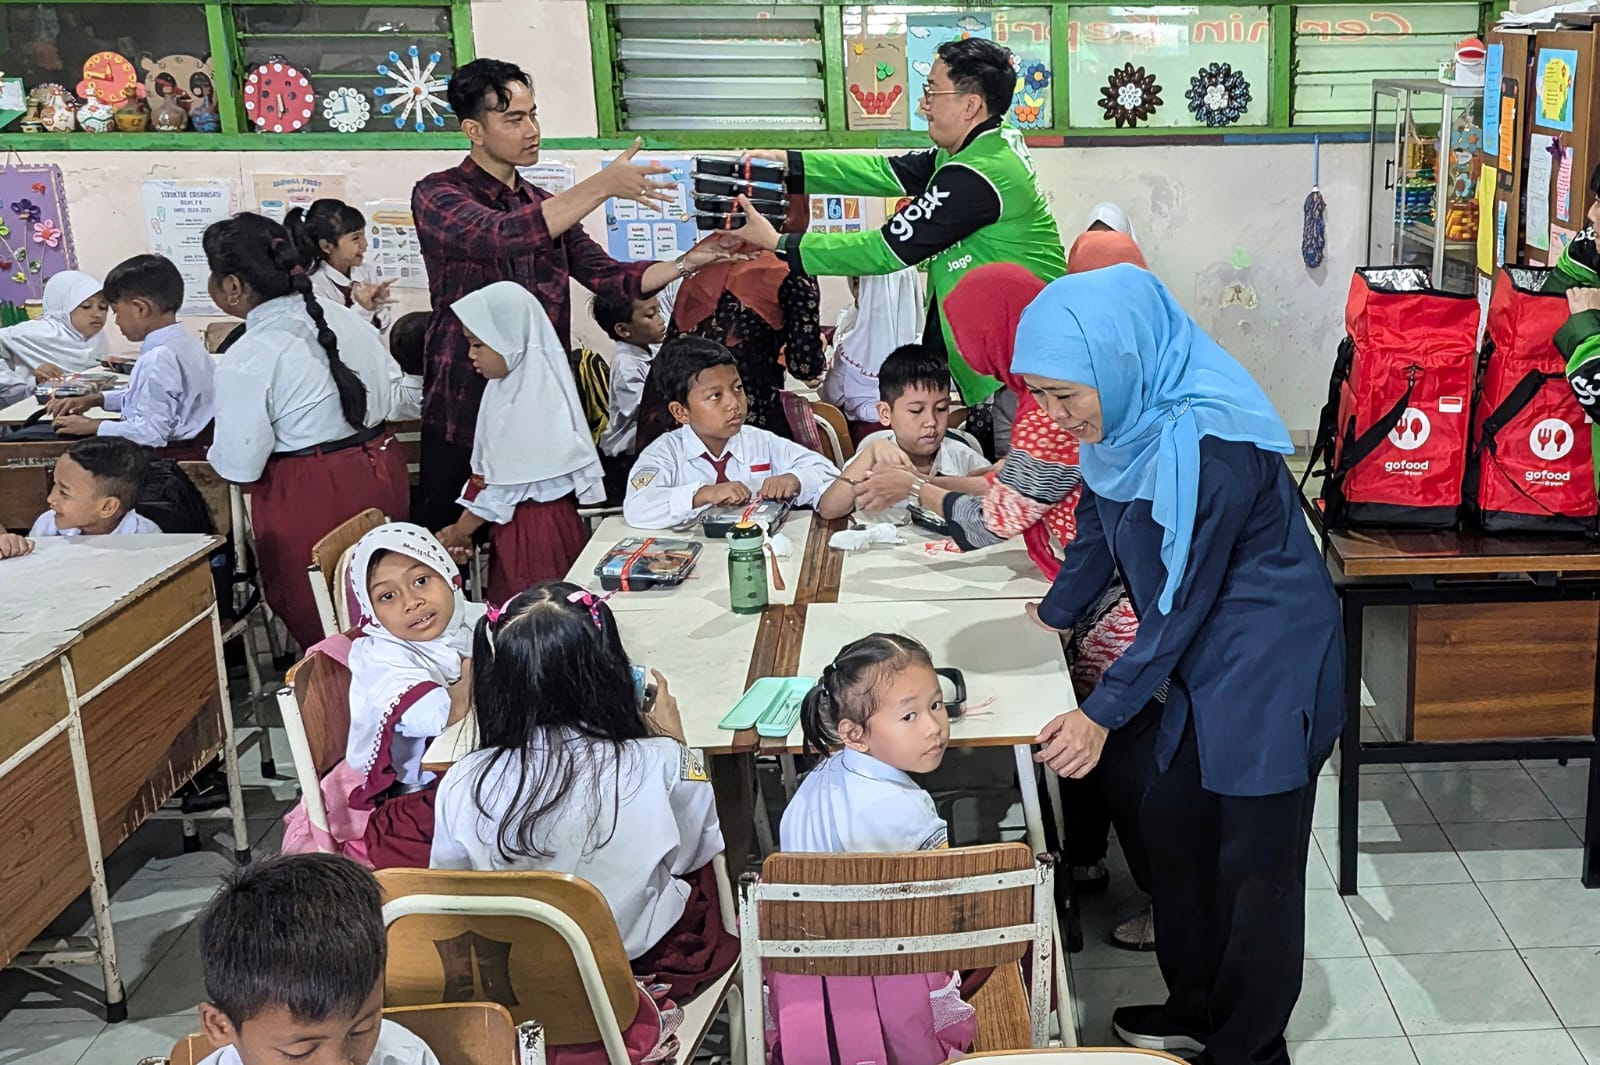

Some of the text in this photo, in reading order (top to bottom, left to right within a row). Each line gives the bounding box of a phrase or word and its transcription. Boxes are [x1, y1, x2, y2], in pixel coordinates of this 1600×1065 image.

[828, 199, 842, 219] 6
[845, 199, 858, 219] 7
[947, 254, 973, 272] Jago
[1385, 460, 1429, 472] gofood
[1525, 470, 1570, 481] gofood
